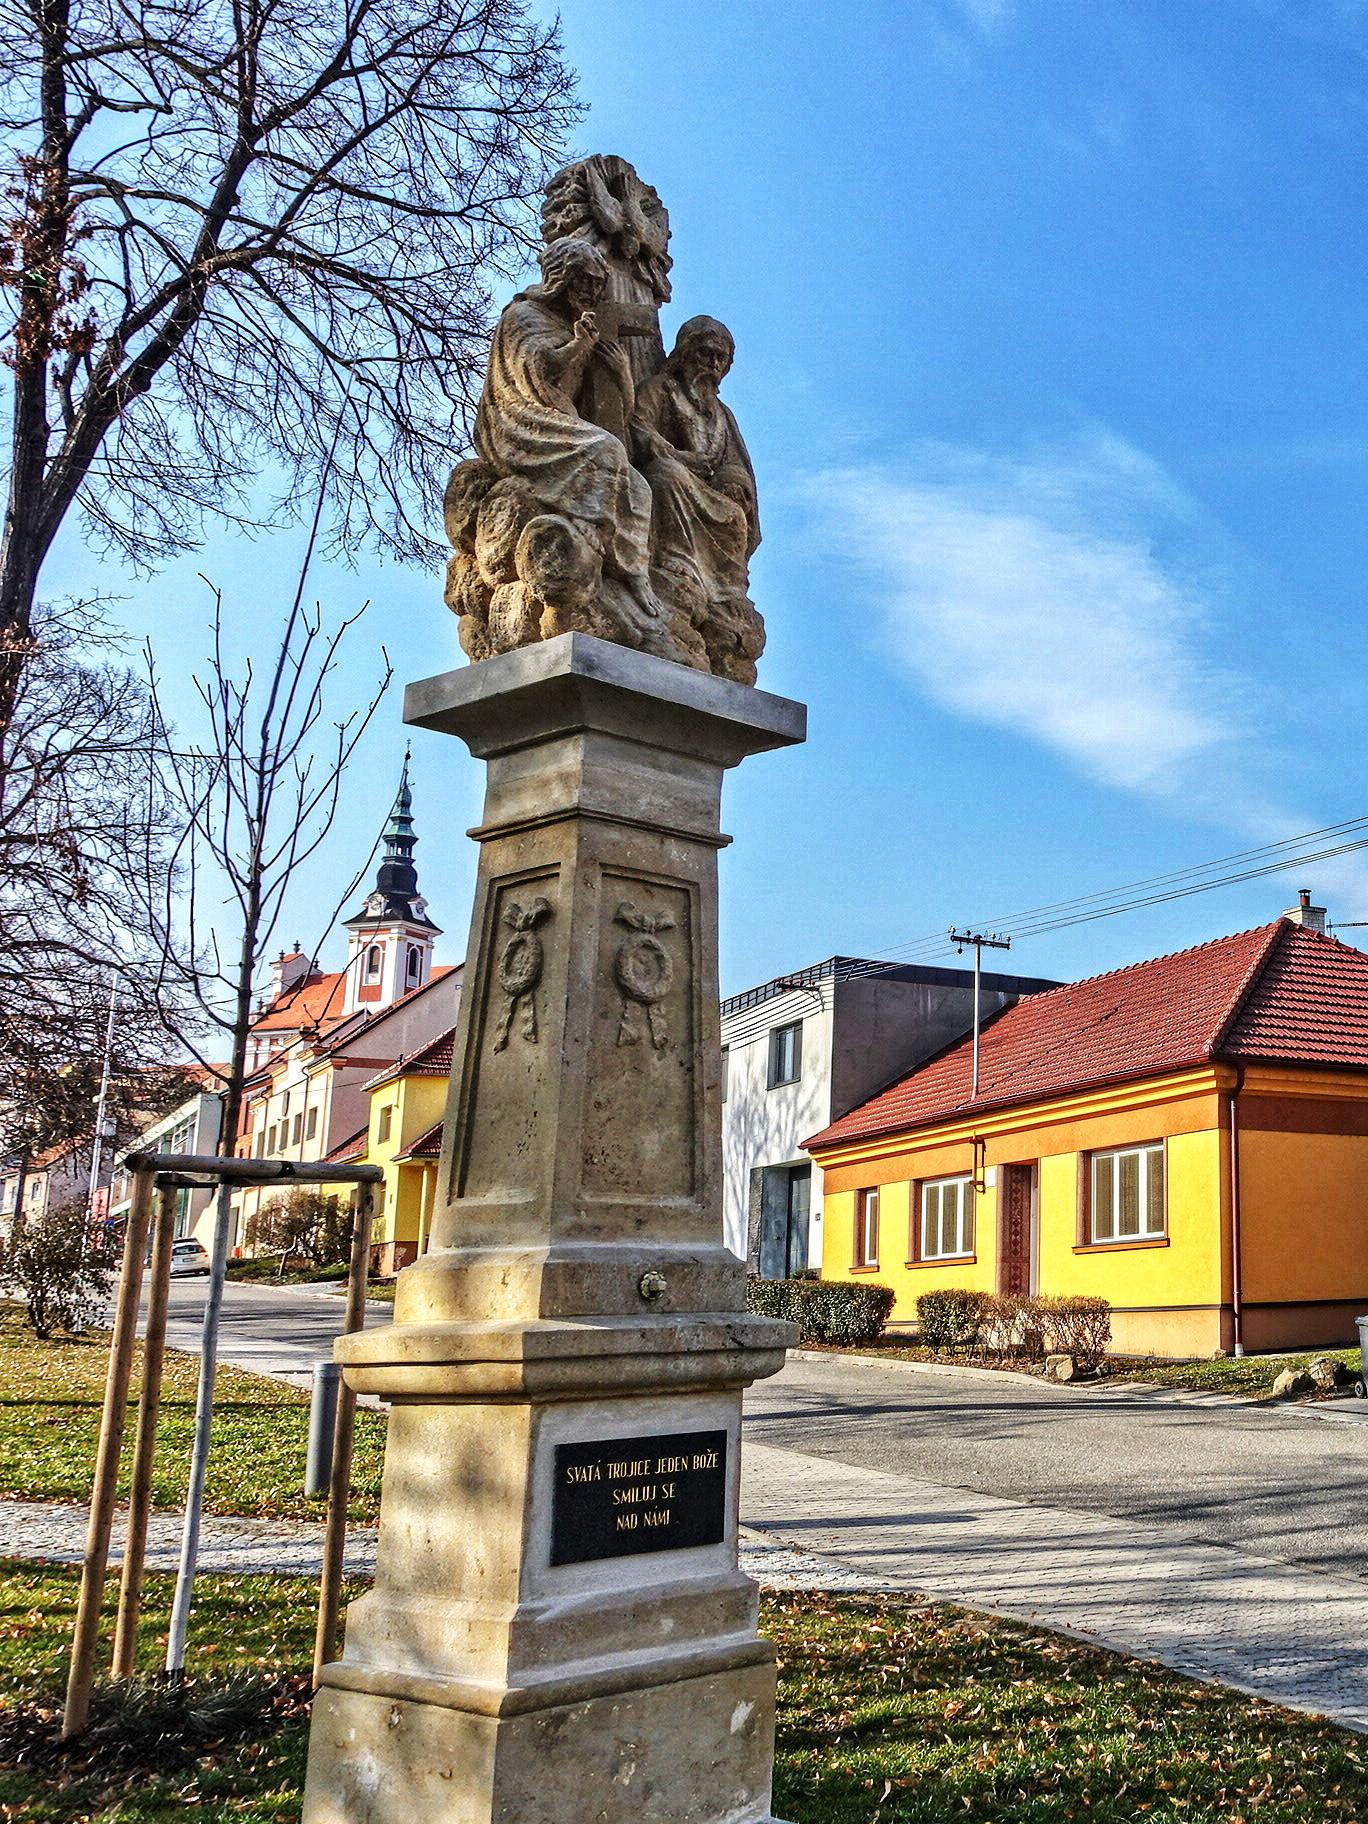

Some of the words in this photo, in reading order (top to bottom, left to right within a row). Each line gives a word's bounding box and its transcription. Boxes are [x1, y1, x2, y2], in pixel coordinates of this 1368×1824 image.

[566, 1460, 601, 1484] SVATÁ
[607, 1460, 651, 1479] TROJICE
[655, 1456, 689, 1474] JEDEN
[693, 1449, 719, 1469] BOŽE
[612, 1485, 656, 1505] SMILUJ
[662, 1483, 677, 1498] SE
[616, 1512, 638, 1530] NAD
[644, 1506, 670, 1526] NÁMI
